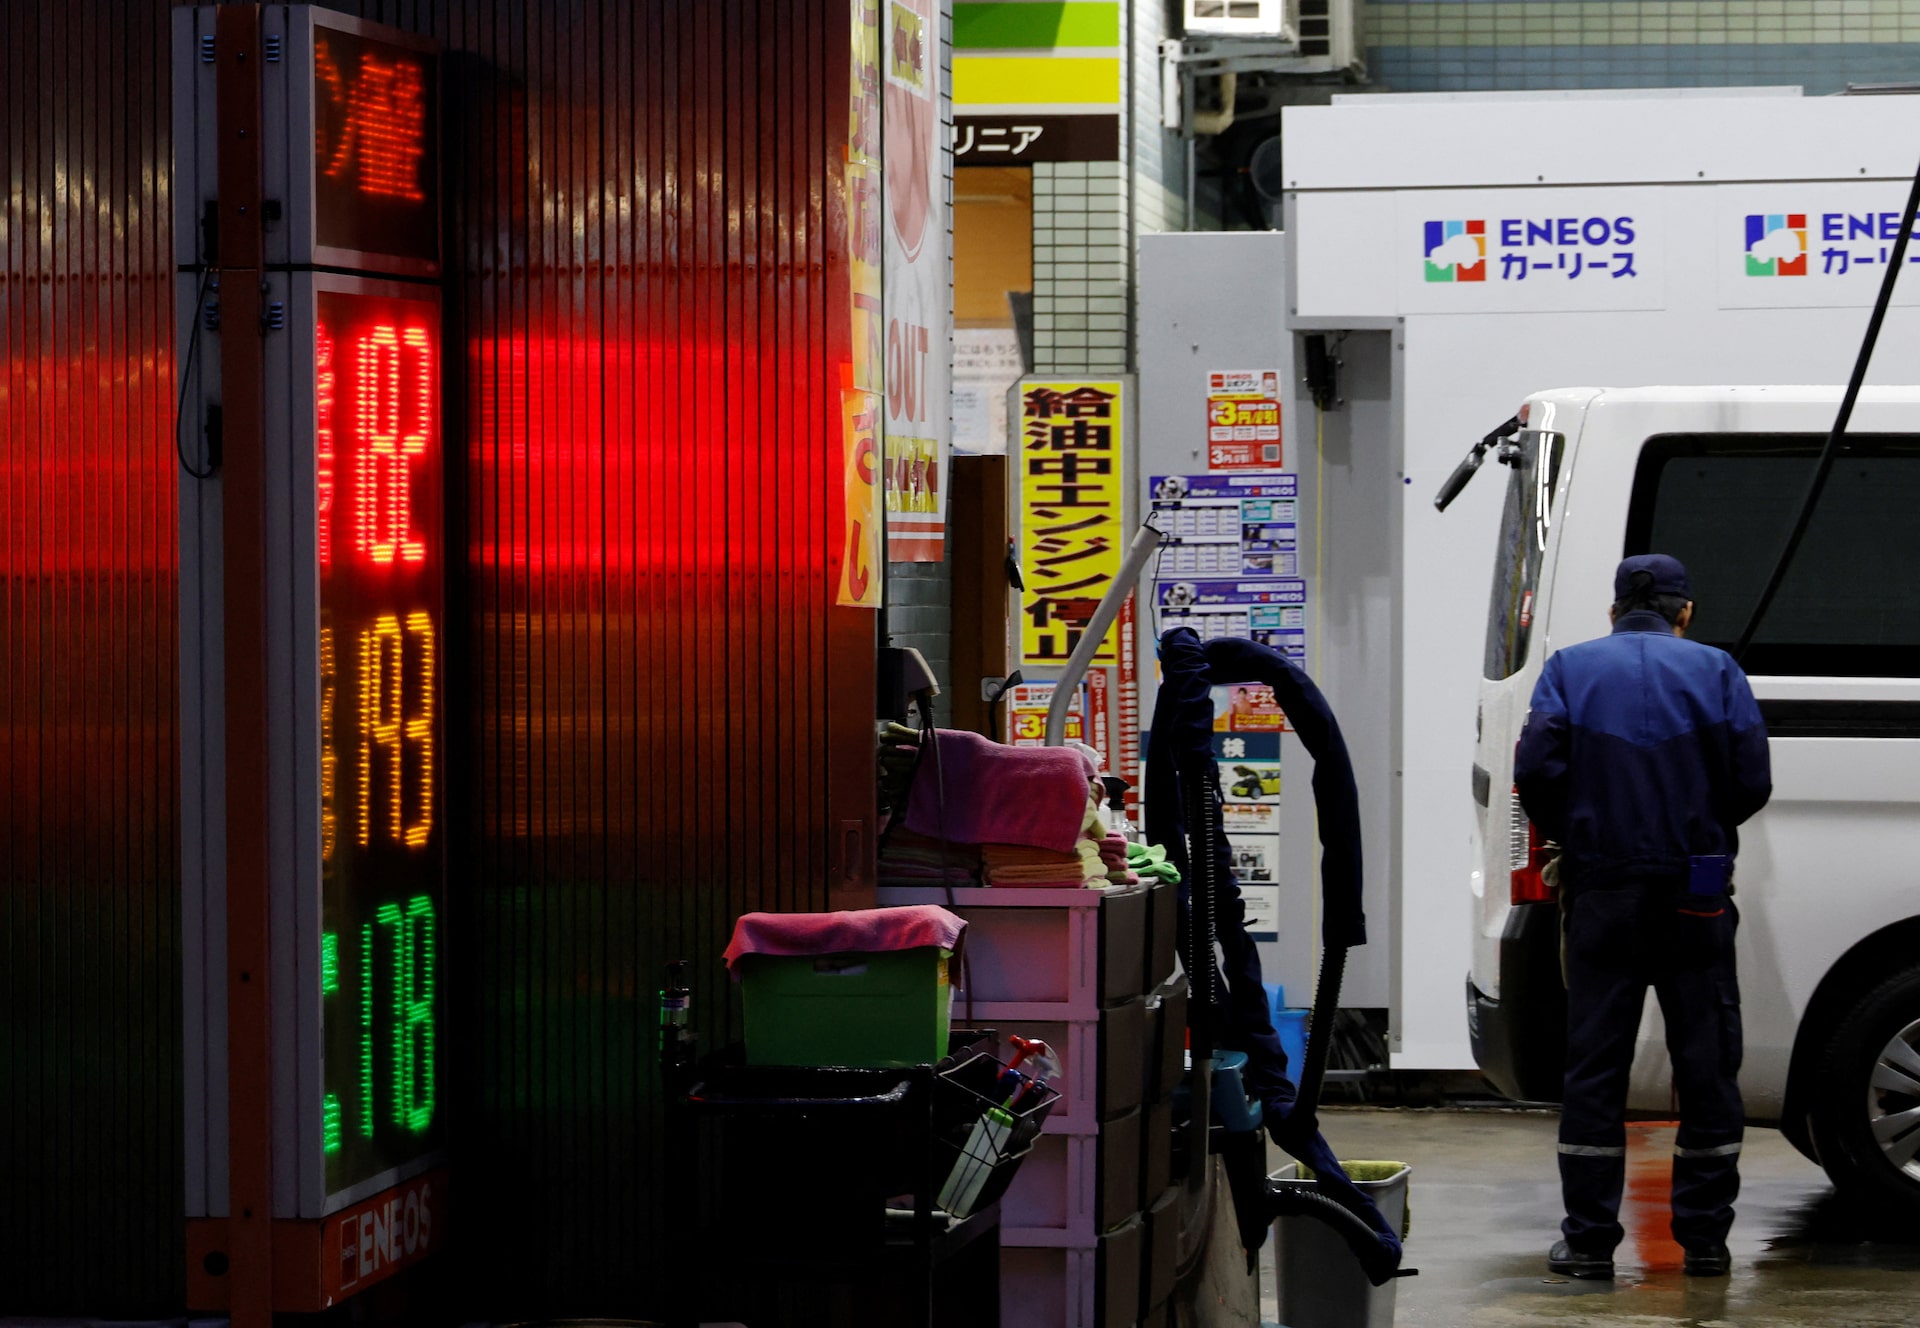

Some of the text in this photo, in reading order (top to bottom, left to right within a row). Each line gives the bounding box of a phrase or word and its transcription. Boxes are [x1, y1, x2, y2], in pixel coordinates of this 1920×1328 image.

[1500, 217, 1635, 246] ENEOS
[1501, 252, 1637, 280] カーリース
[356, 324, 433, 564] 182
[887, 318, 929, 423] OUT
[1024, 387, 1118, 659] 給油中エンジン停止
[357, 611, 435, 847] 193
[360, 895, 435, 1139] 178
[359, 1183, 432, 1278] ENEOS
